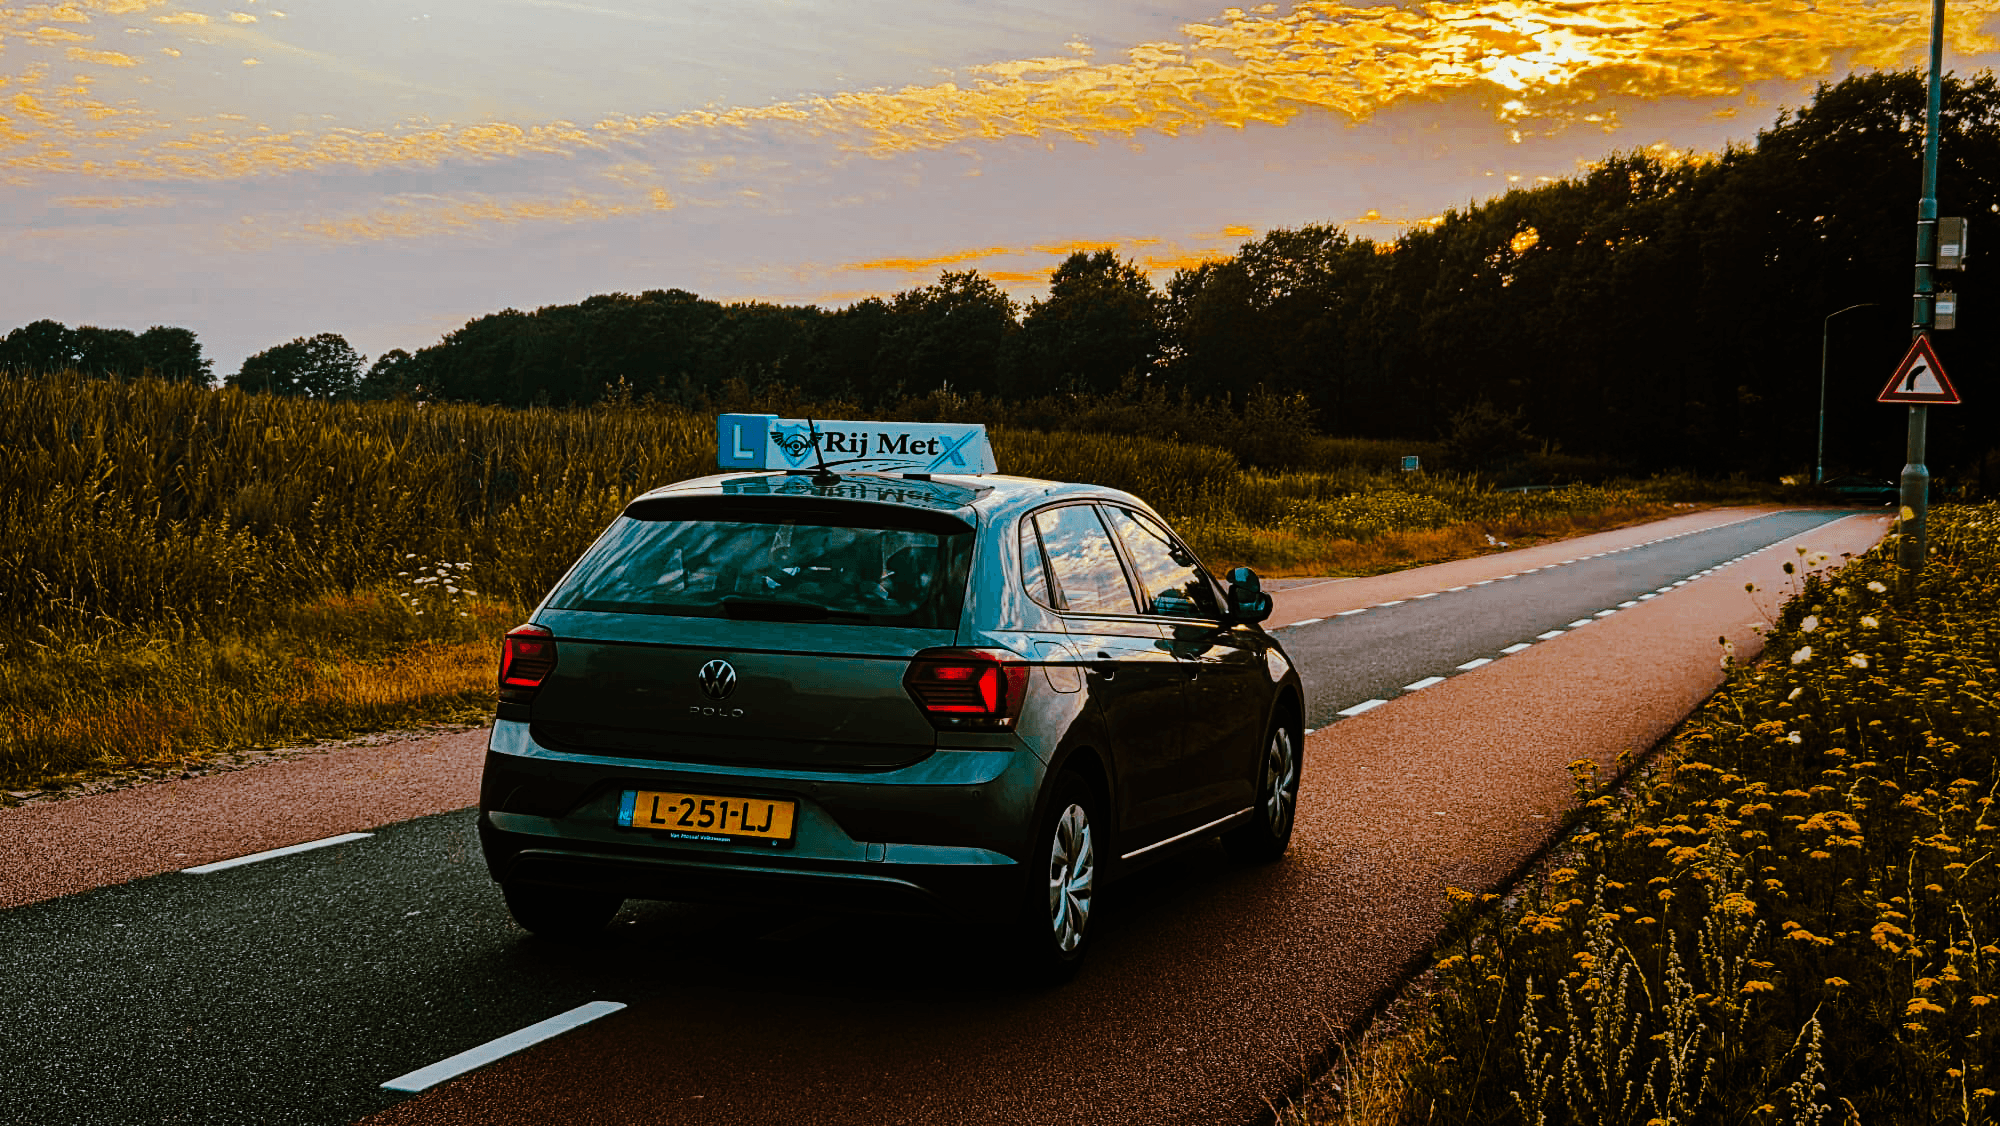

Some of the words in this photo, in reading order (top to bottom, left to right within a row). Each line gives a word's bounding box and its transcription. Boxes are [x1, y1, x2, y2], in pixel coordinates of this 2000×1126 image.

[734, 424, 754, 460] L
[824, 432, 868, 458] Rij
[690, 706, 744, 717] POLO
[650, 795, 774, 832] L-251-LJ
